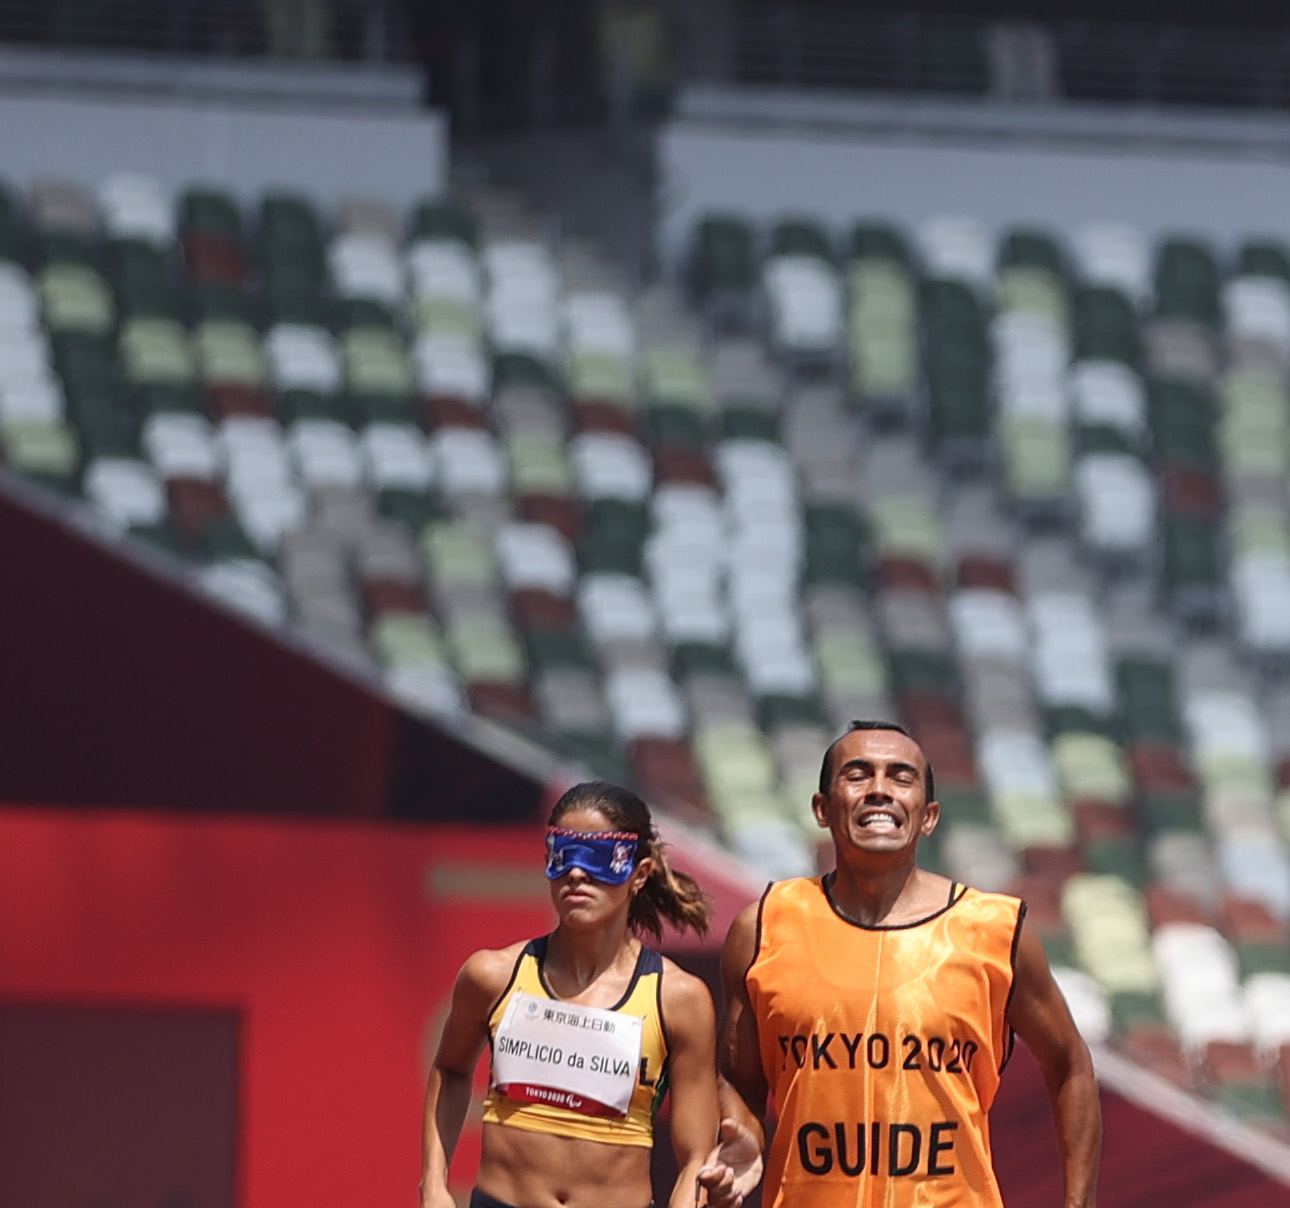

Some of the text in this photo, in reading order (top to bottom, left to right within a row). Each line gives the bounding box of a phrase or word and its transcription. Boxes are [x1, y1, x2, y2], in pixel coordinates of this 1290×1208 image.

[543, 1008, 616, 1034] 東京海上日動
[498, 1036, 563, 1065] SIMPLICIO
[567, 1052, 585, 1069] da
[590, 1055, 631, 1078] SILVA
[778, 1032, 978, 1073] TOKYO 2020
[525, 1086, 565, 1104] TOKYO 2020
[797, 1121, 959, 1177] GUIDE
